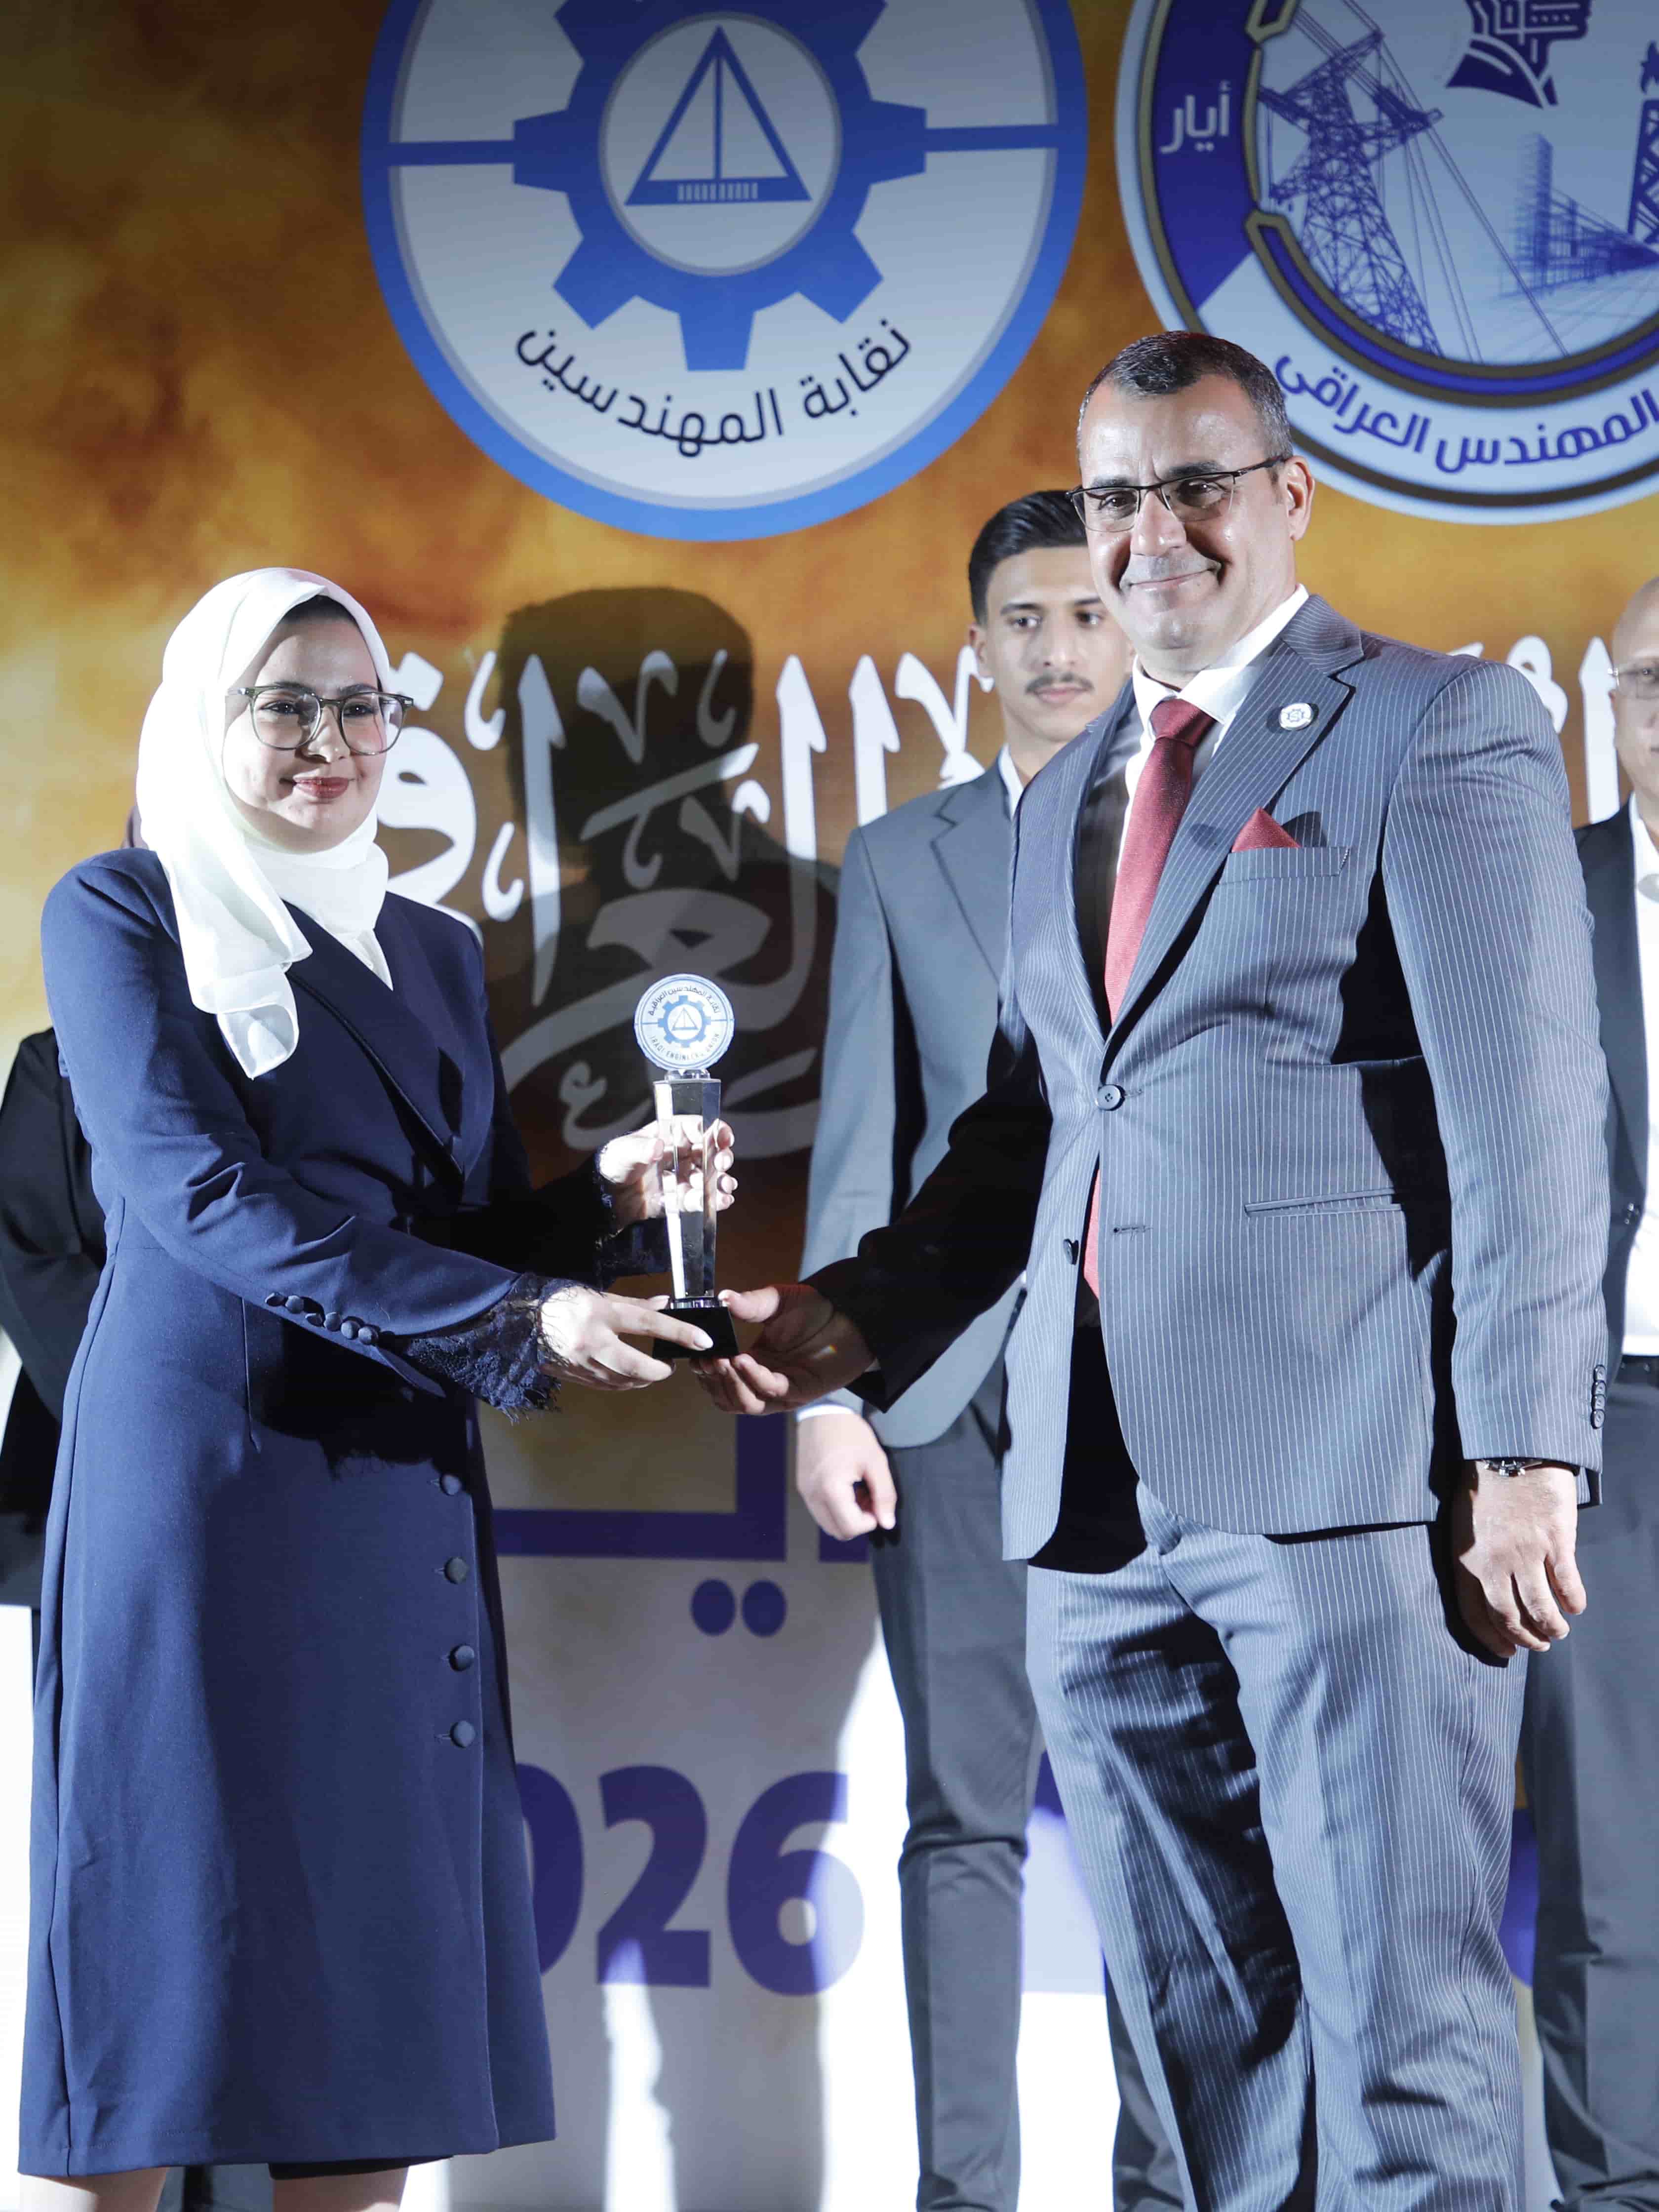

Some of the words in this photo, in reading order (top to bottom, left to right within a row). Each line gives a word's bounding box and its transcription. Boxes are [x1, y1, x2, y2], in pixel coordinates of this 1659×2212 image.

[1159, 79, 1232, 155] أيار
[515, 328, 784, 458] المهندسين
[799, 318, 911, 419] نقابة
[1435, 388, 1659, 474] المهندس
[651, 1035, 665, 1052] IRAQI
